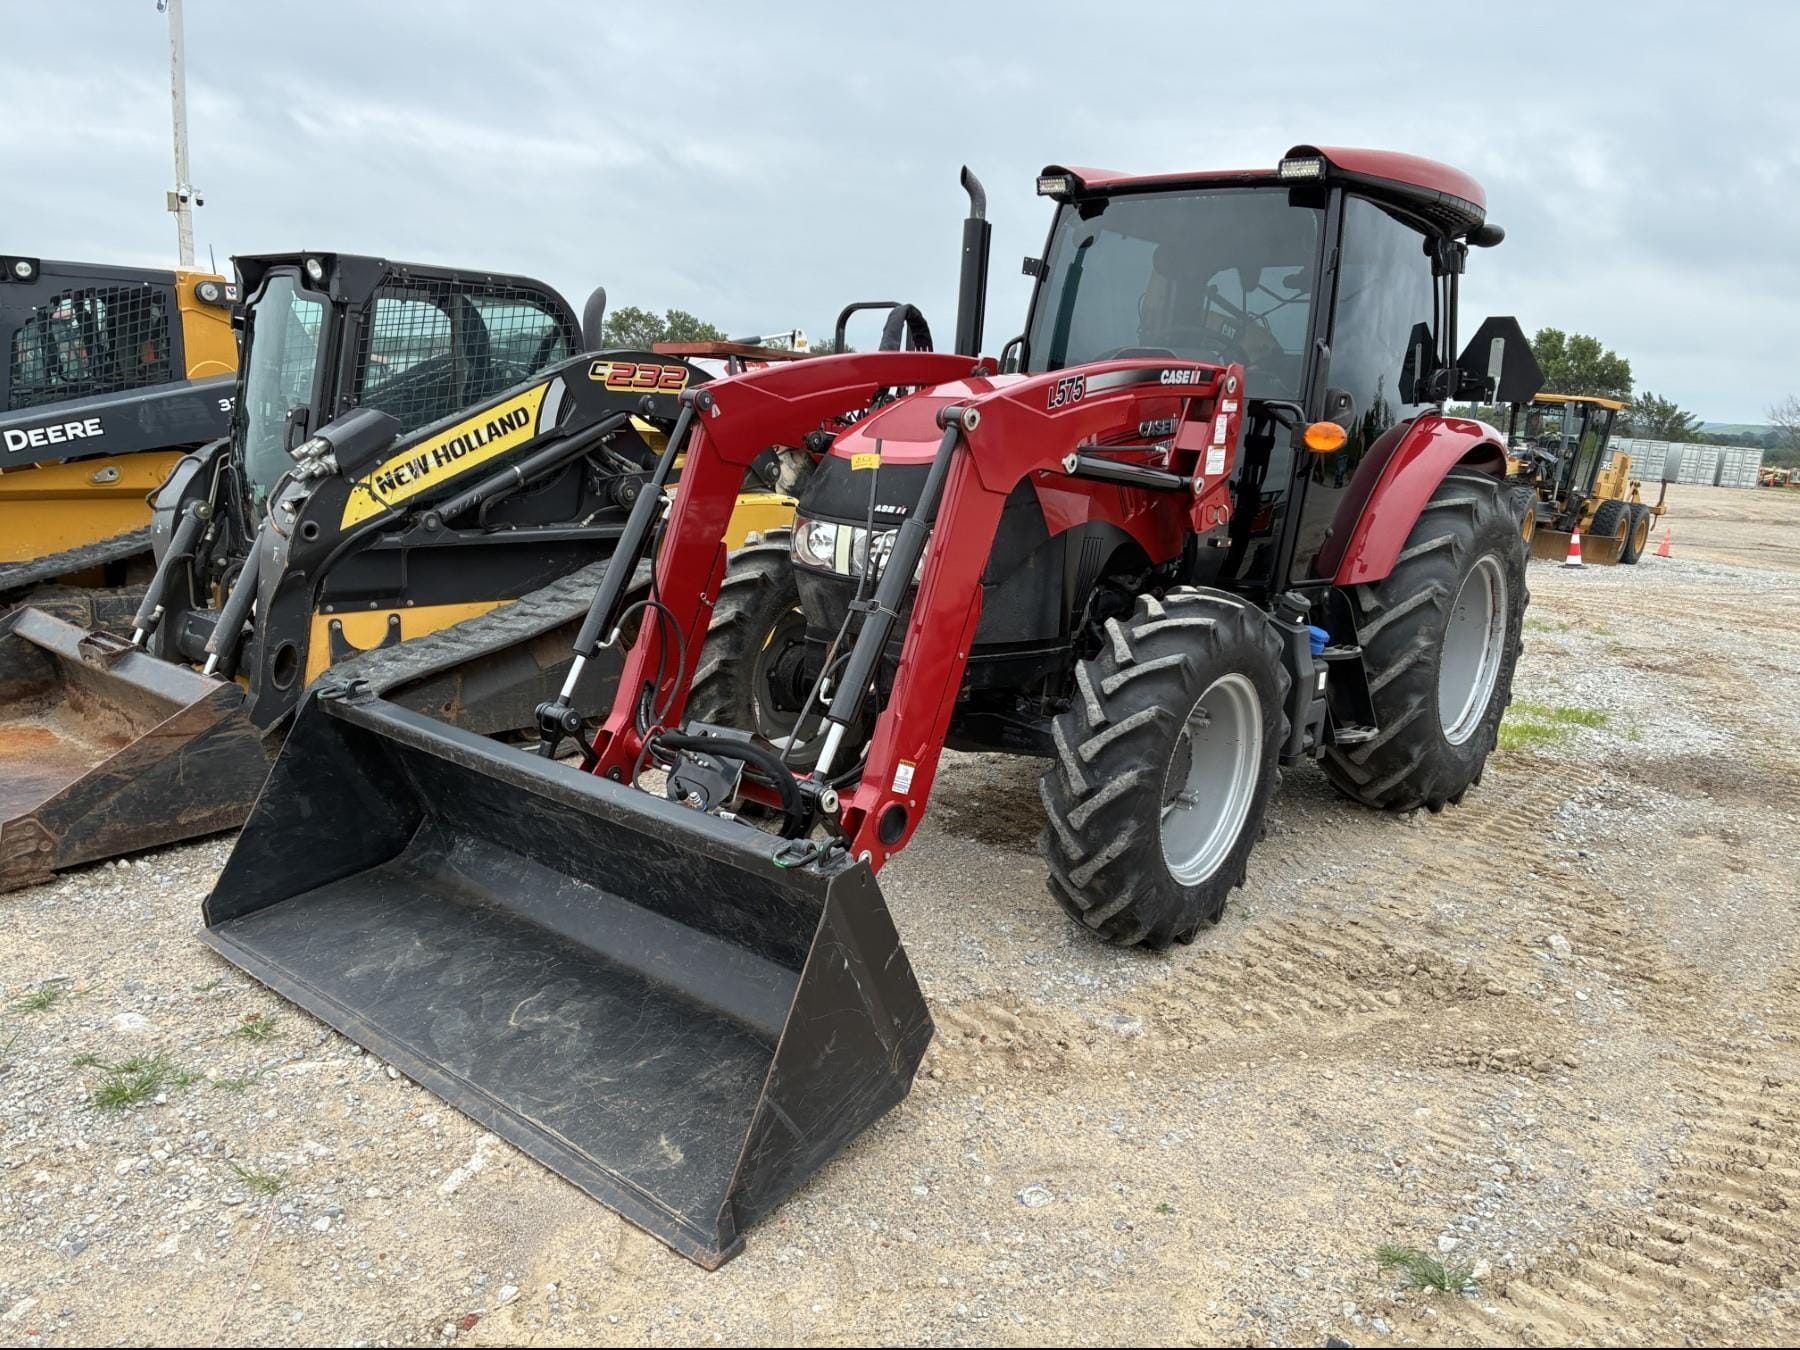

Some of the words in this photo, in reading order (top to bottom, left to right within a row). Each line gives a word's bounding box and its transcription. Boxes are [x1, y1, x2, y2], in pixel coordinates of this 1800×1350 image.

[589, 362, 688, 391] C232
[1160, 369, 1190, 385] CASE
[1047, 374, 1085, 410] L575
[1549, 408, 1565, 416] DEE
[3, 417, 104, 452] DEERE
[1139, 419, 1170, 438] CASE
[375, 454, 430, 494] NEW
[432, 406, 530, 468] HOLLAND
[867, 504, 896, 514] ASE
